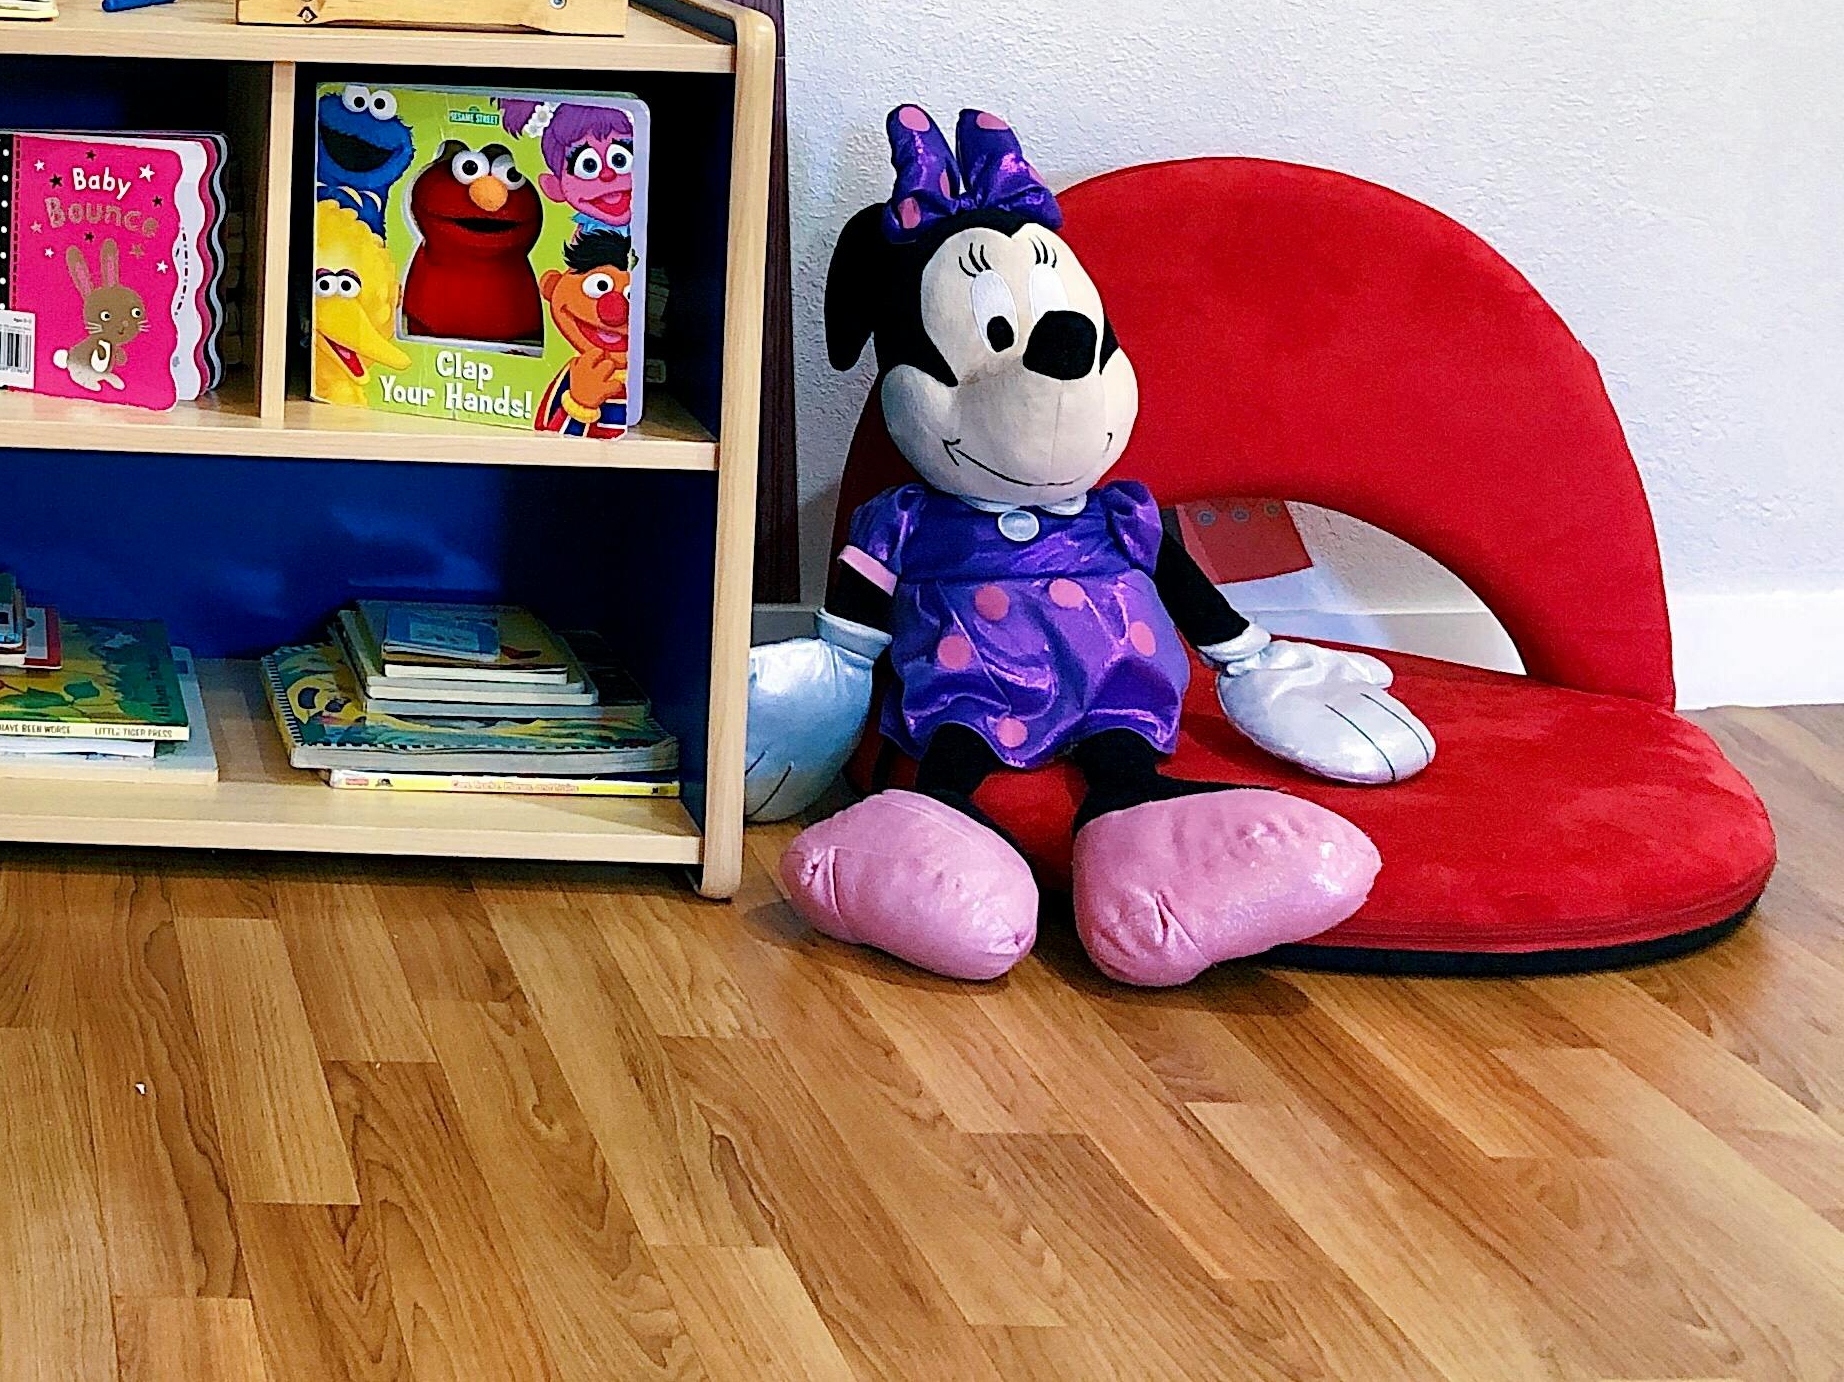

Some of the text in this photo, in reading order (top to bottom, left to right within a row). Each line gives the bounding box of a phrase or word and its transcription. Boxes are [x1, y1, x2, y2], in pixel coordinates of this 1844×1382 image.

[72, 166, 132, 201] Baby
[44, 196, 159, 239] Bounce
[435, 350, 494, 389] Clap
[378, 375, 533, 418] Your Hands!
[21, 724, 42, 734] BEEN
